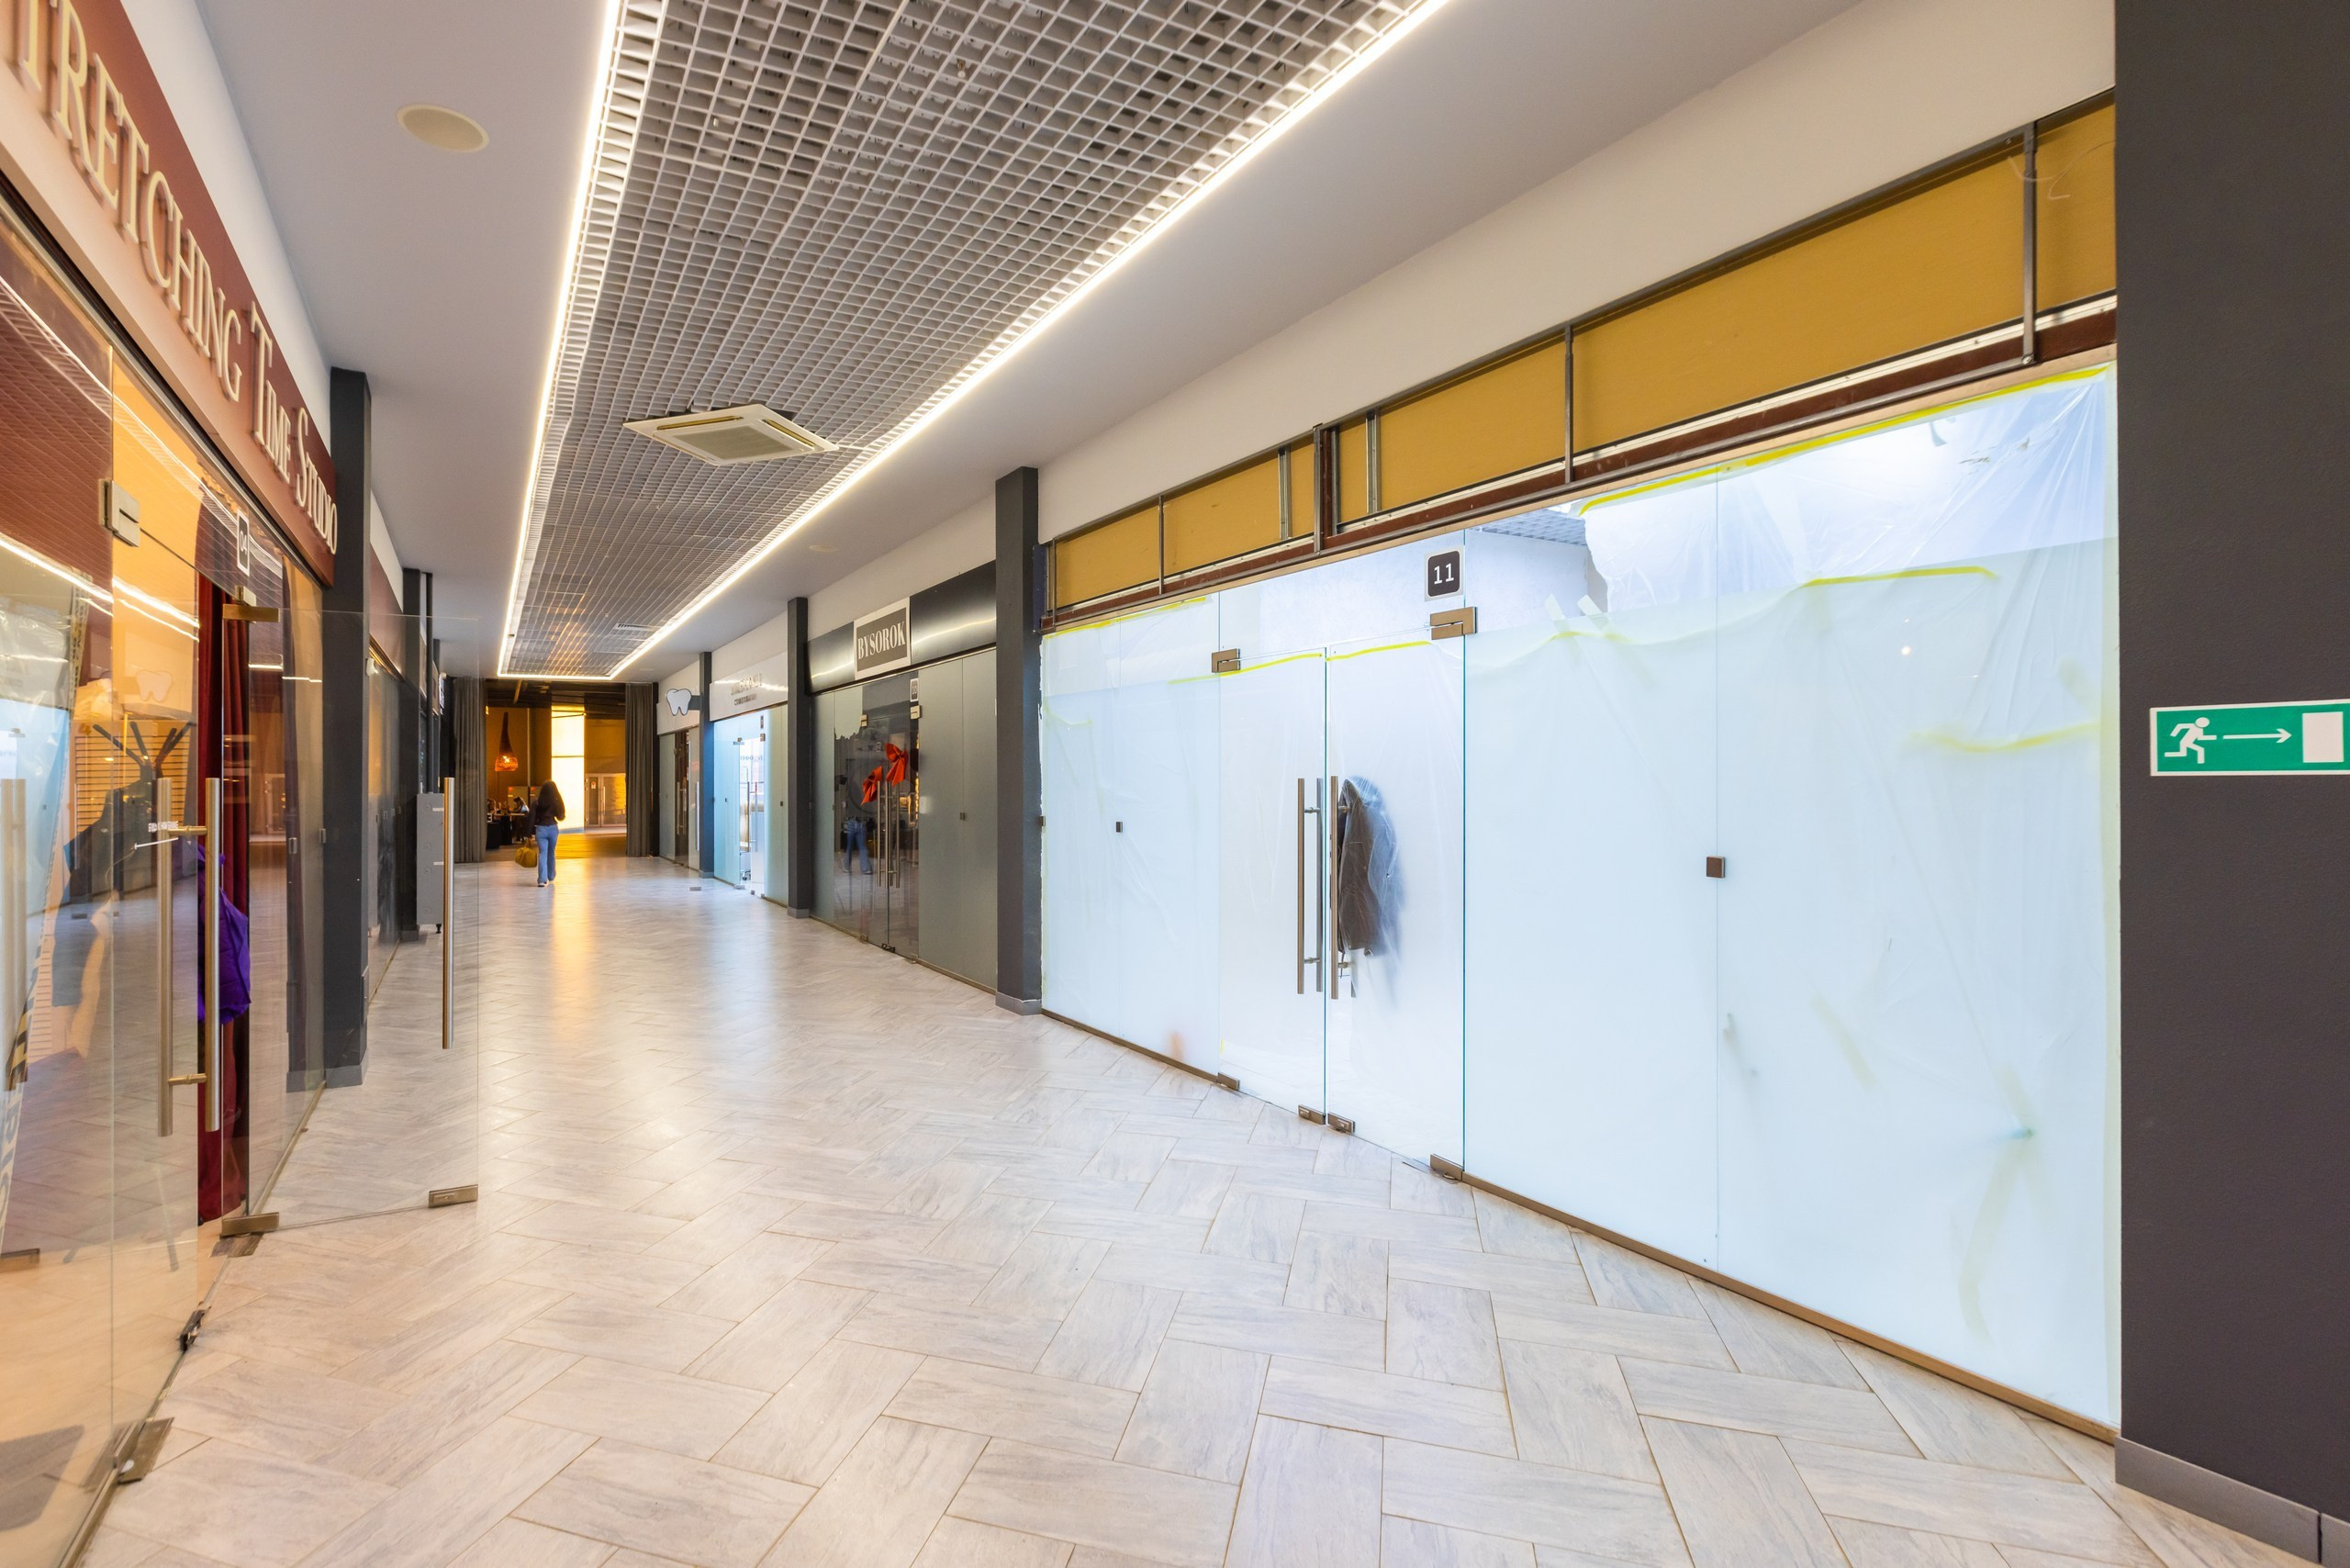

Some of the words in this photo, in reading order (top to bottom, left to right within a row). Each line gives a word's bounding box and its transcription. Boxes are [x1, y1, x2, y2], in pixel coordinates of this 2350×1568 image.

[251, 300, 291, 485] TIME
[297, 407, 338, 555] STUDIO
[240, 530, 248, 555] 04
[1434, 563, 1455, 585] 11
[857, 621, 906, 660] BYSOROK
